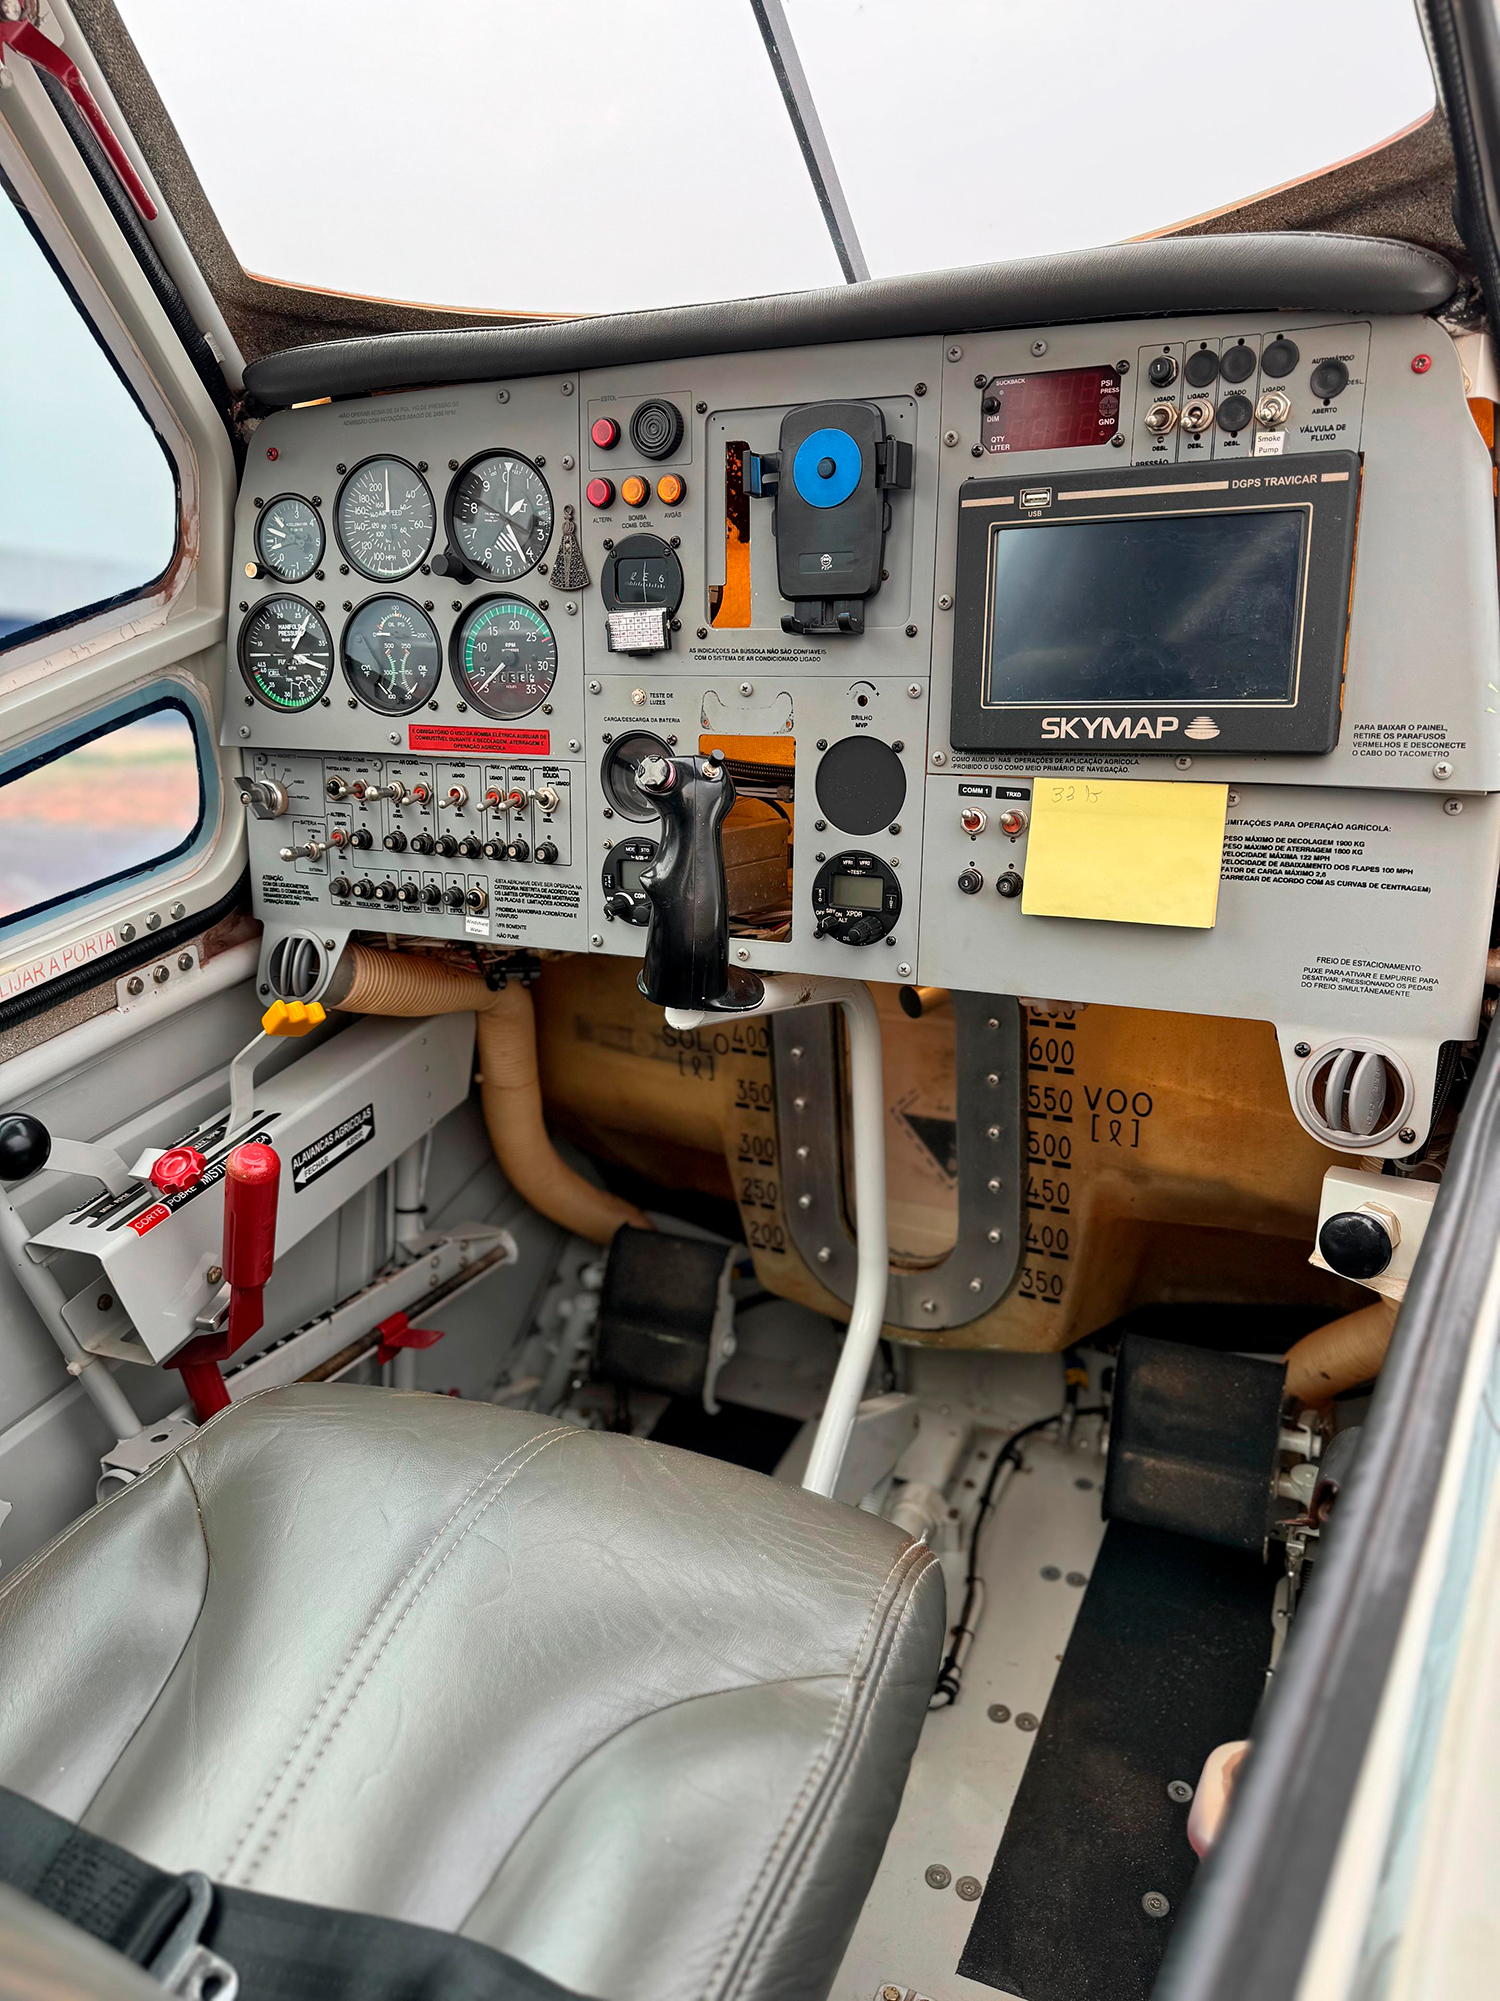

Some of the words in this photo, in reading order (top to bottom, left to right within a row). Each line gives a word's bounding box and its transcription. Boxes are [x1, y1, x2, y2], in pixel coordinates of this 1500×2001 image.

[1300, 424, 1335, 433] VÁLVULA
[369, 483, 382, 491] 200
[483, 481, 490, 492] 9
[1232, 478, 1261, 490] DGPS
[1264, 474, 1317, 486] TRAVICAR
[406, 490, 416, 498] 40
[536, 494, 543, 506] 2
[470, 502, 478, 514] 8
[414, 520, 424, 528] 60
[470, 528, 477, 539] 7
[537, 529, 544, 541] 3
[402, 550, 411, 558] 80
[485, 548, 492, 559] 6
[505, 556, 513, 567] 5
[659, 574, 664, 583] 6
[488, 626, 498, 636] 15
[509, 621, 520, 630] 20
[526, 632, 537, 642] 25
[476, 643, 487, 652] 10
[480, 667, 486, 676] 5
[537, 661, 548, 670] 30
[526, 685, 536, 694] 35
[1041, 716, 1179, 739] SKYMAP
[1297, 821, 1343, 831] OPERAÇÃO
[1287, 838, 1334, 846] DECOLAGEM
[1269, 852, 1298, 860] MÁXIMA
[1279, 861, 1333, 870] ABAIXAMENTO
[1284, 868, 1314, 877] MÁXIMO
[1380, 883, 1431, 894] CENTRAGEM)
[50, 956, 61, 975] A
[63, 930, 116, 969] PORTA
[1345, 970, 1371, 979] ATIVAR
[1380, 974, 1417, 983] EMPURRE
[1338, 984, 1410, 997] SIMULTÂNEAMENTE
[1341, 978, 1395, 988] PRESSIONANDO
[1408, 984, 1433, 992] PEDAIS
[661, 1025, 729, 1056] SOLO
[732, 1024, 769, 1049] 400
[1029, 1036, 1075, 1066] 600
[736, 1078, 771, 1105] 350
[1028, 1085, 1073, 1114] 550
[1084, 1085, 1153, 1118] VOO
[346, 1131, 364, 1147] ABRIR
[740, 1133, 774, 1159] 300
[1027, 1131, 1071, 1160] 500
[293, 1134, 334, 1170] ALAVANCAS
[304, 1155, 329, 1177] FECHAR
[742, 1177, 777, 1201] 250
[1025, 1176, 1070, 1205] 450
[134, 1207, 165, 1229] CORTE
[751, 1221, 785, 1246] 200
[1025, 1222, 1069, 1251] 400
[1021, 1268, 1063, 1296] 350
